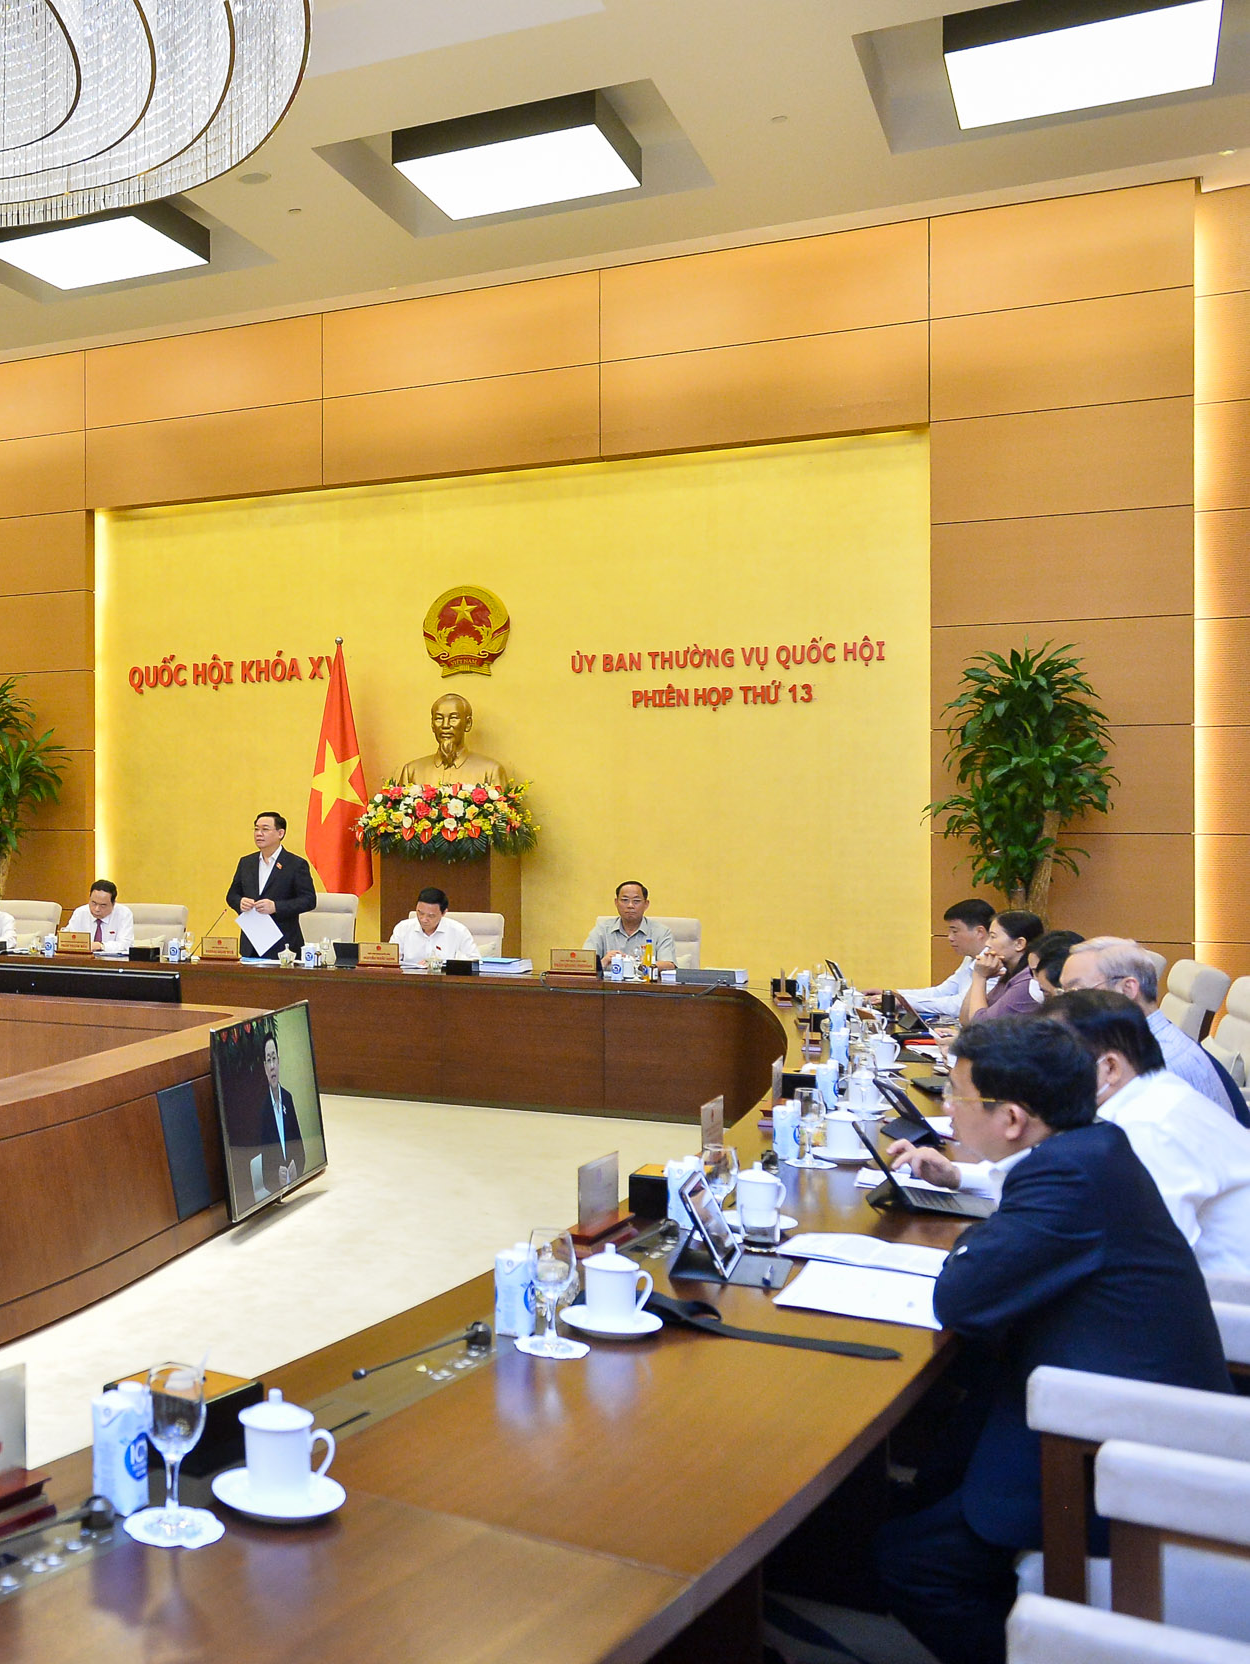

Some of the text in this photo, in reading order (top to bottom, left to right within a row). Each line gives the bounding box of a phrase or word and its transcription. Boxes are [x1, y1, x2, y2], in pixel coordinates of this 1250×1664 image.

[128, 654, 187, 694] QUỐC
[193, 653, 234, 691] HỘI
[241, 650, 302, 683] KHÓA
[571, 635, 886, 673] ỦY BAN THƯỜNG VỤ QUỐC HỘI
[632, 679, 814, 712] PHIÊN HỌP THỨ 13
